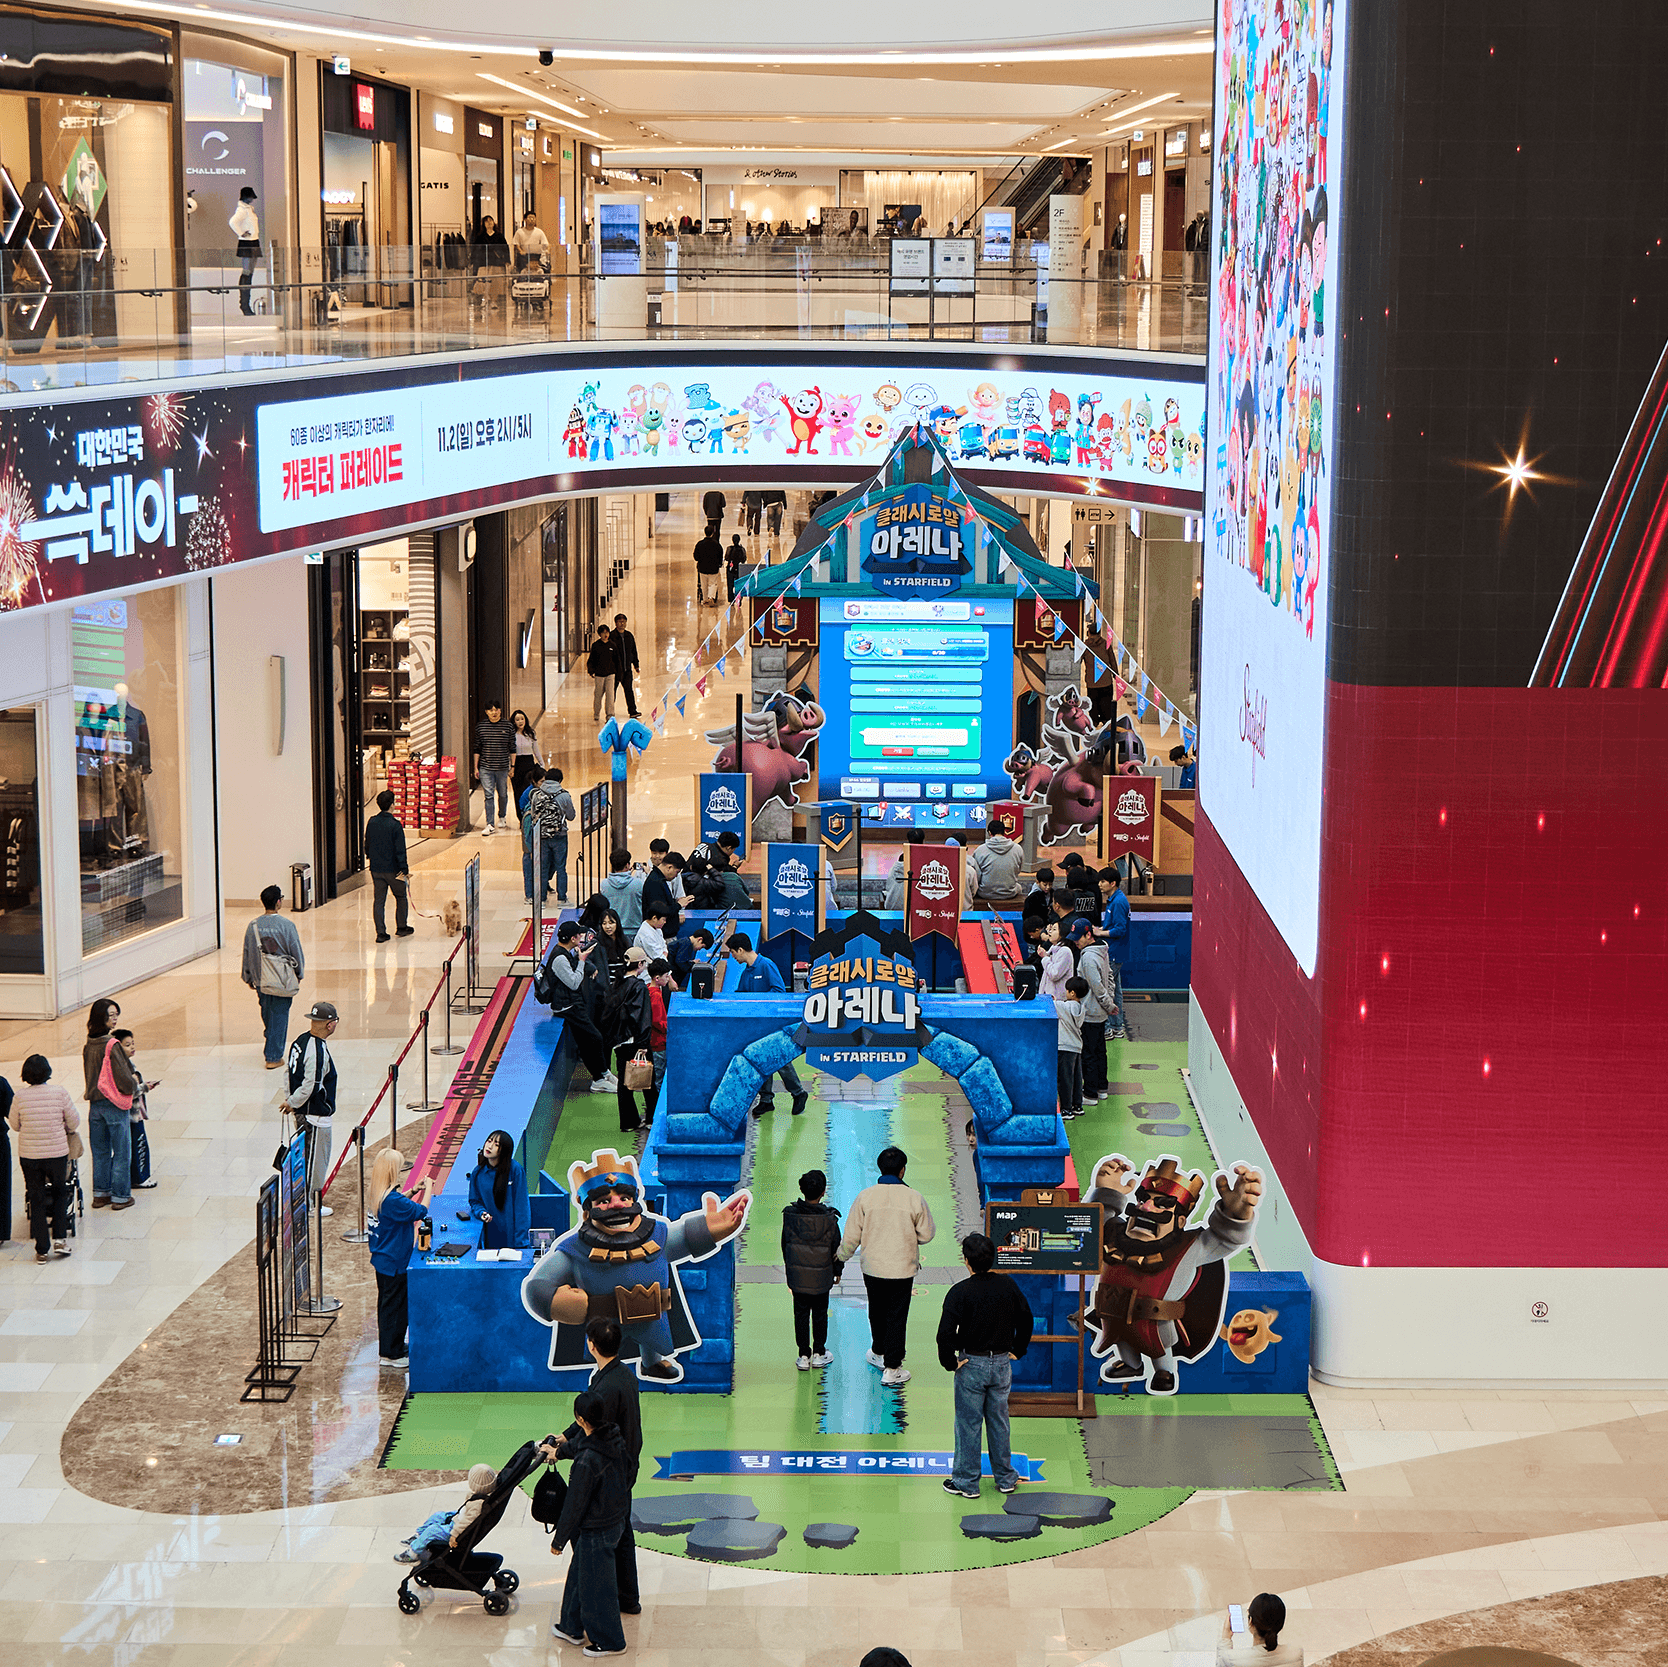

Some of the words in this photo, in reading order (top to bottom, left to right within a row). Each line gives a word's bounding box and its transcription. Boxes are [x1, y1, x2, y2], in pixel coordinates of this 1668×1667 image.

[744, 169, 752, 178] &
[773, 168, 797, 178] Stories
[1054, 208, 1065, 217] 2F
[290, 427, 308, 446] 60종
[309, 423, 332, 443] 이상의
[334, 419, 363, 440] 캐릭터가
[364, 414, 395, 435] 한자리에!
[438, 421, 473, 452] 11.2(일)
[476, 418, 495, 446] 오후
[498, 413, 532, 442] 2시/5시
[77, 425, 144, 468] 대한민국
[282, 453, 334, 501] 캐릭터
[340, 442, 404, 491] 퍼레이드
[876, 502, 960, 528] 클래시로얄
[871, 525, 963, 561] 아레나
[893, 577, 952, 587] STARFIELD
[709, 799, 737, 810] 아레나
[1118, 801, 1145, 812] 아레나
[779, 873, 808, 884] 아레나
[920, 874, 951, 886] 아레나
[810, 957, 916, 989] 클래시로얄
[804, 986, 921, 1030] 아레나
[833, 1051, 907, 1063] STARFIELD
[739, 1454, 770, 1469] 팀
[780, 1454, 848, 1469] 대전
